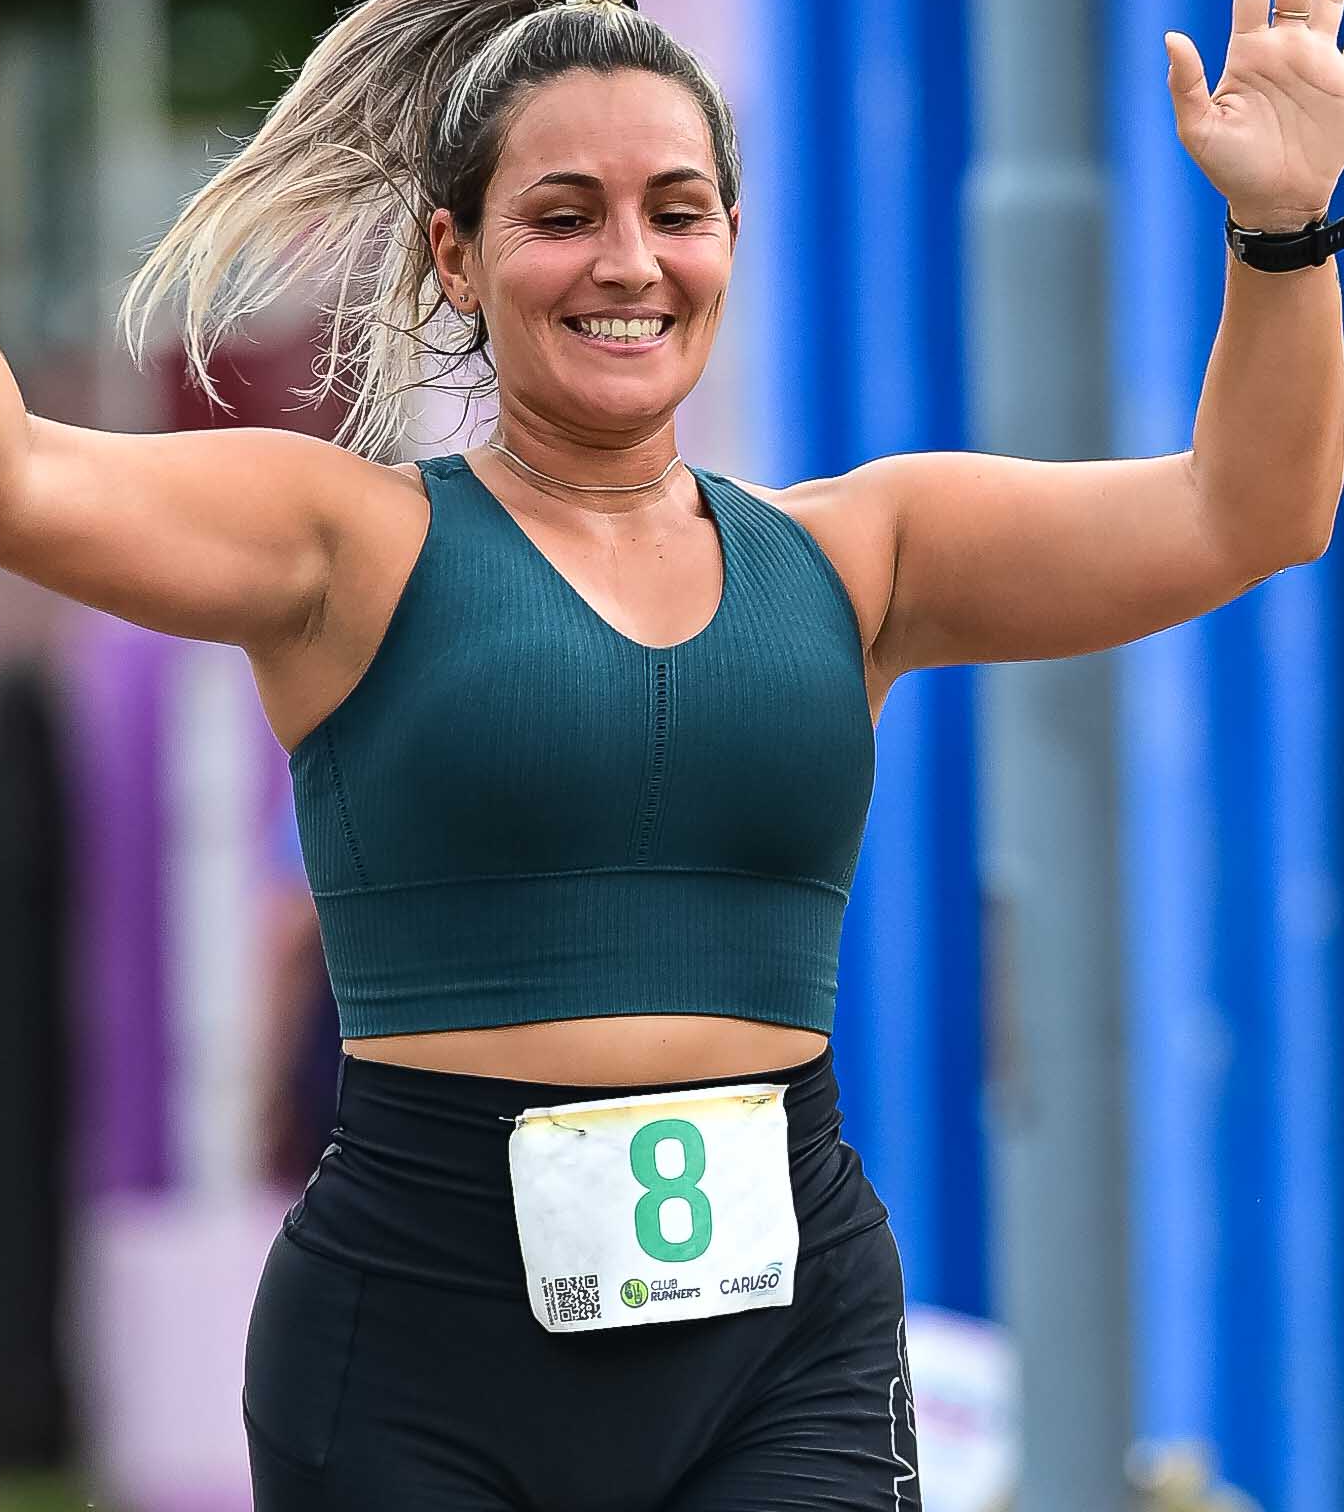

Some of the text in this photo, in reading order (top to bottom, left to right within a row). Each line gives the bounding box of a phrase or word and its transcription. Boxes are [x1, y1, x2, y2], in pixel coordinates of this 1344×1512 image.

[629, 1118, 712, 1263] 8
[650, 1278, 678, 1291] CLUB
[720, 1273, 780, 1295] CARUSO
